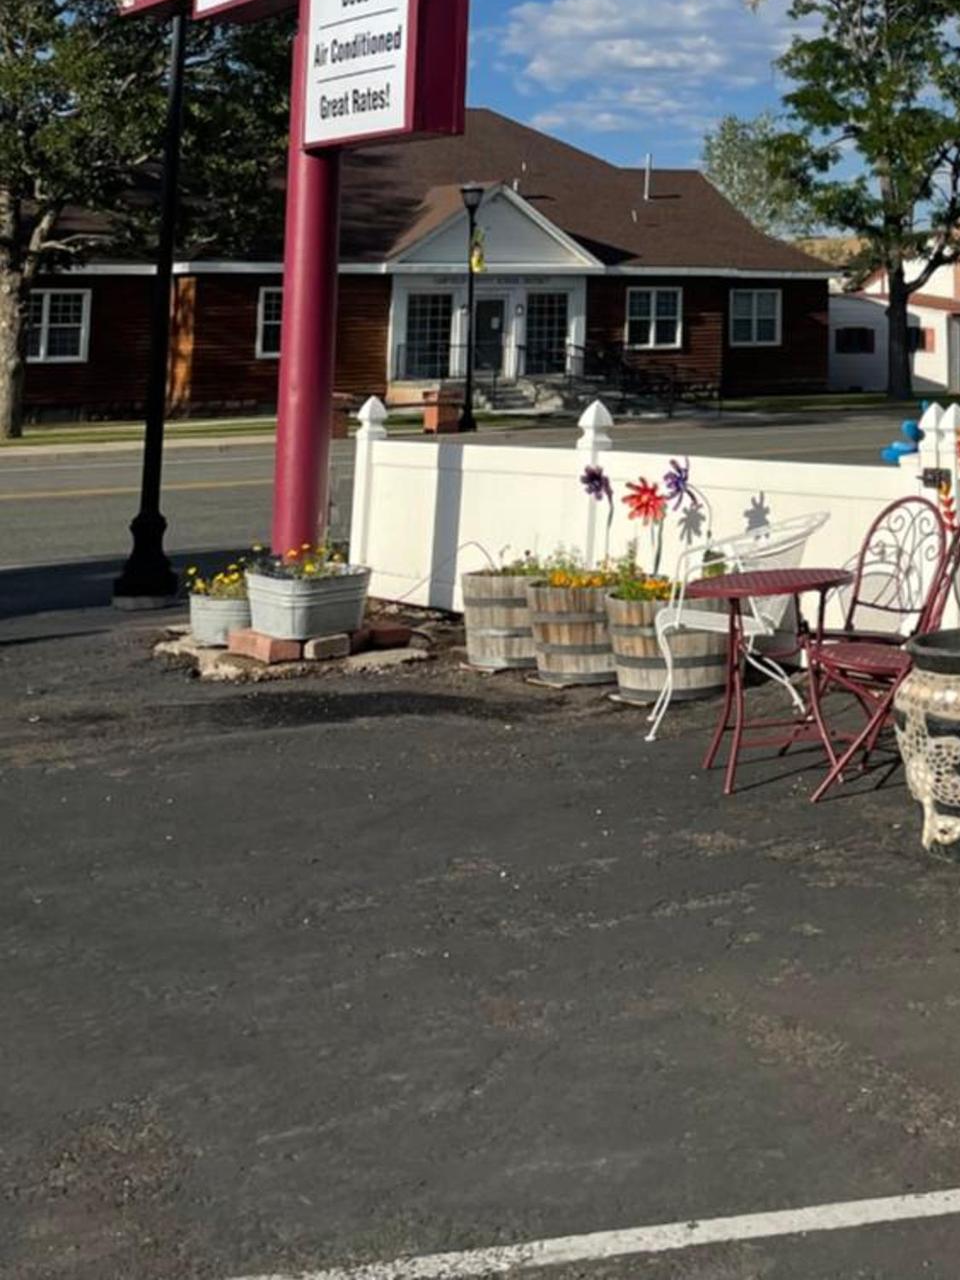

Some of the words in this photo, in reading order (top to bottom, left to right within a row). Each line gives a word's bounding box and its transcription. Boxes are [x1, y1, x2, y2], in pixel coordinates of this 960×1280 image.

[314, 42, 329, 68] Air
[330, 23, 403, 64] Conditioned
[319, 91, 350, 120] Great
[352, 81, 391, 114] Rates!
